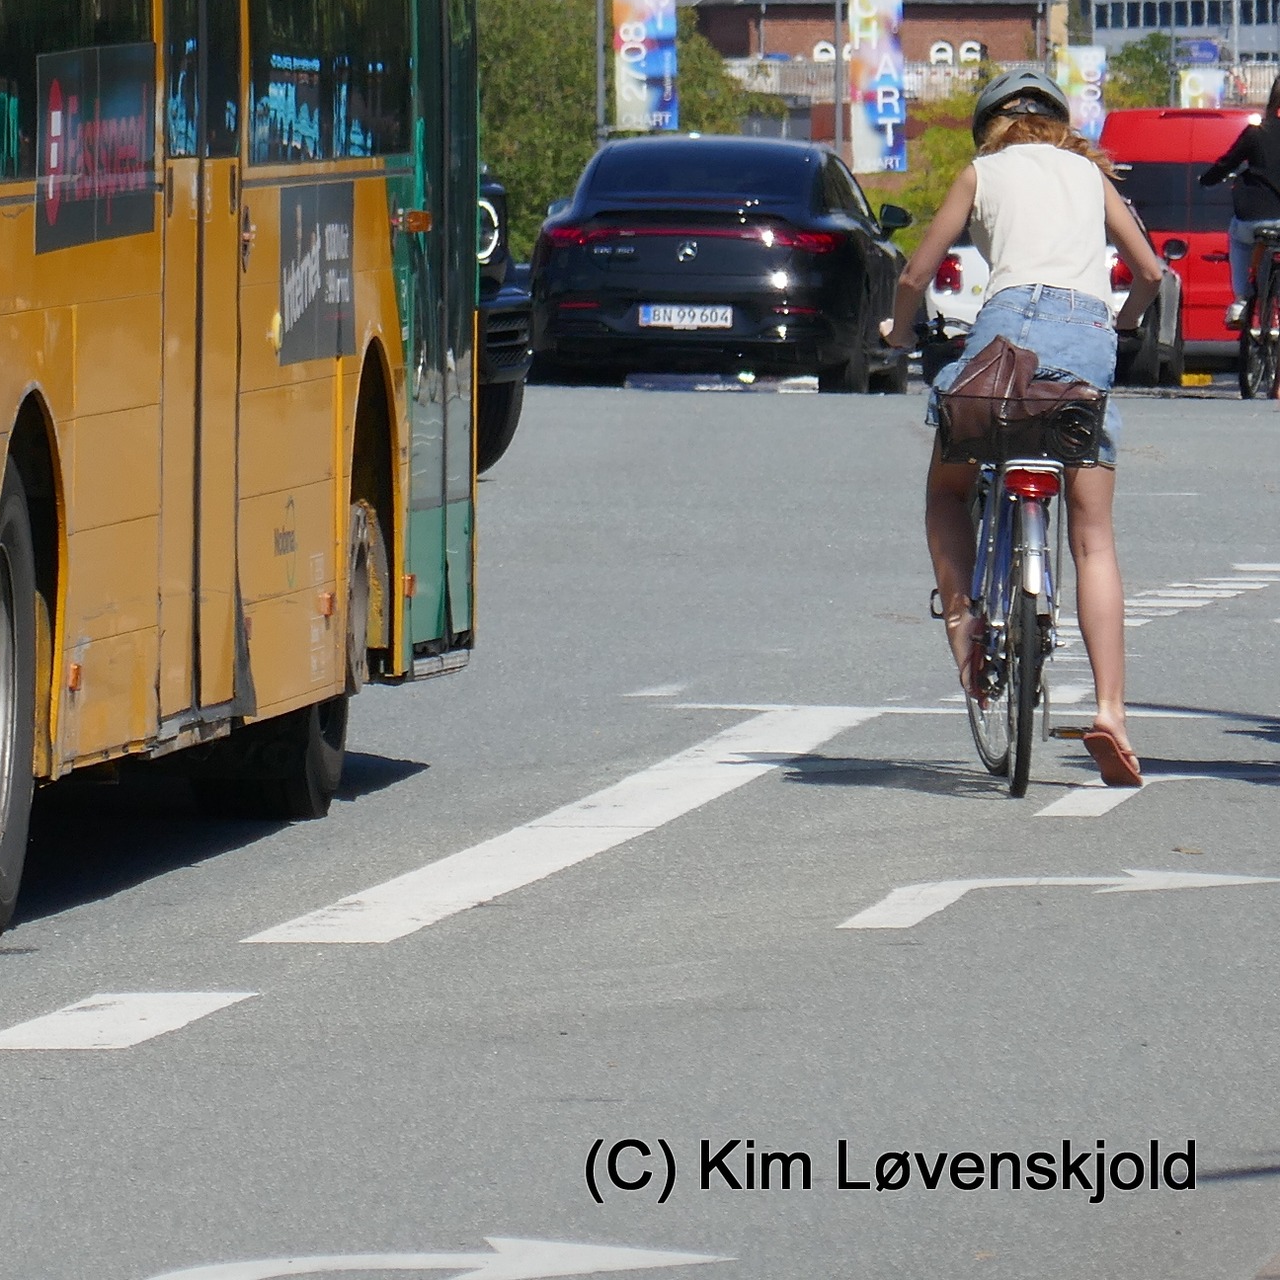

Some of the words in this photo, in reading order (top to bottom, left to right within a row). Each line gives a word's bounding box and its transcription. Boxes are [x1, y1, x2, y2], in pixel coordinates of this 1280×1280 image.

[619, 20, 647, 102] 27.08
[622, 111, 672, 127] CHART
[652, 309, 673, 322] BN
[677, 308, 697, 323] 99
[699, 309, 730, 323] 604
